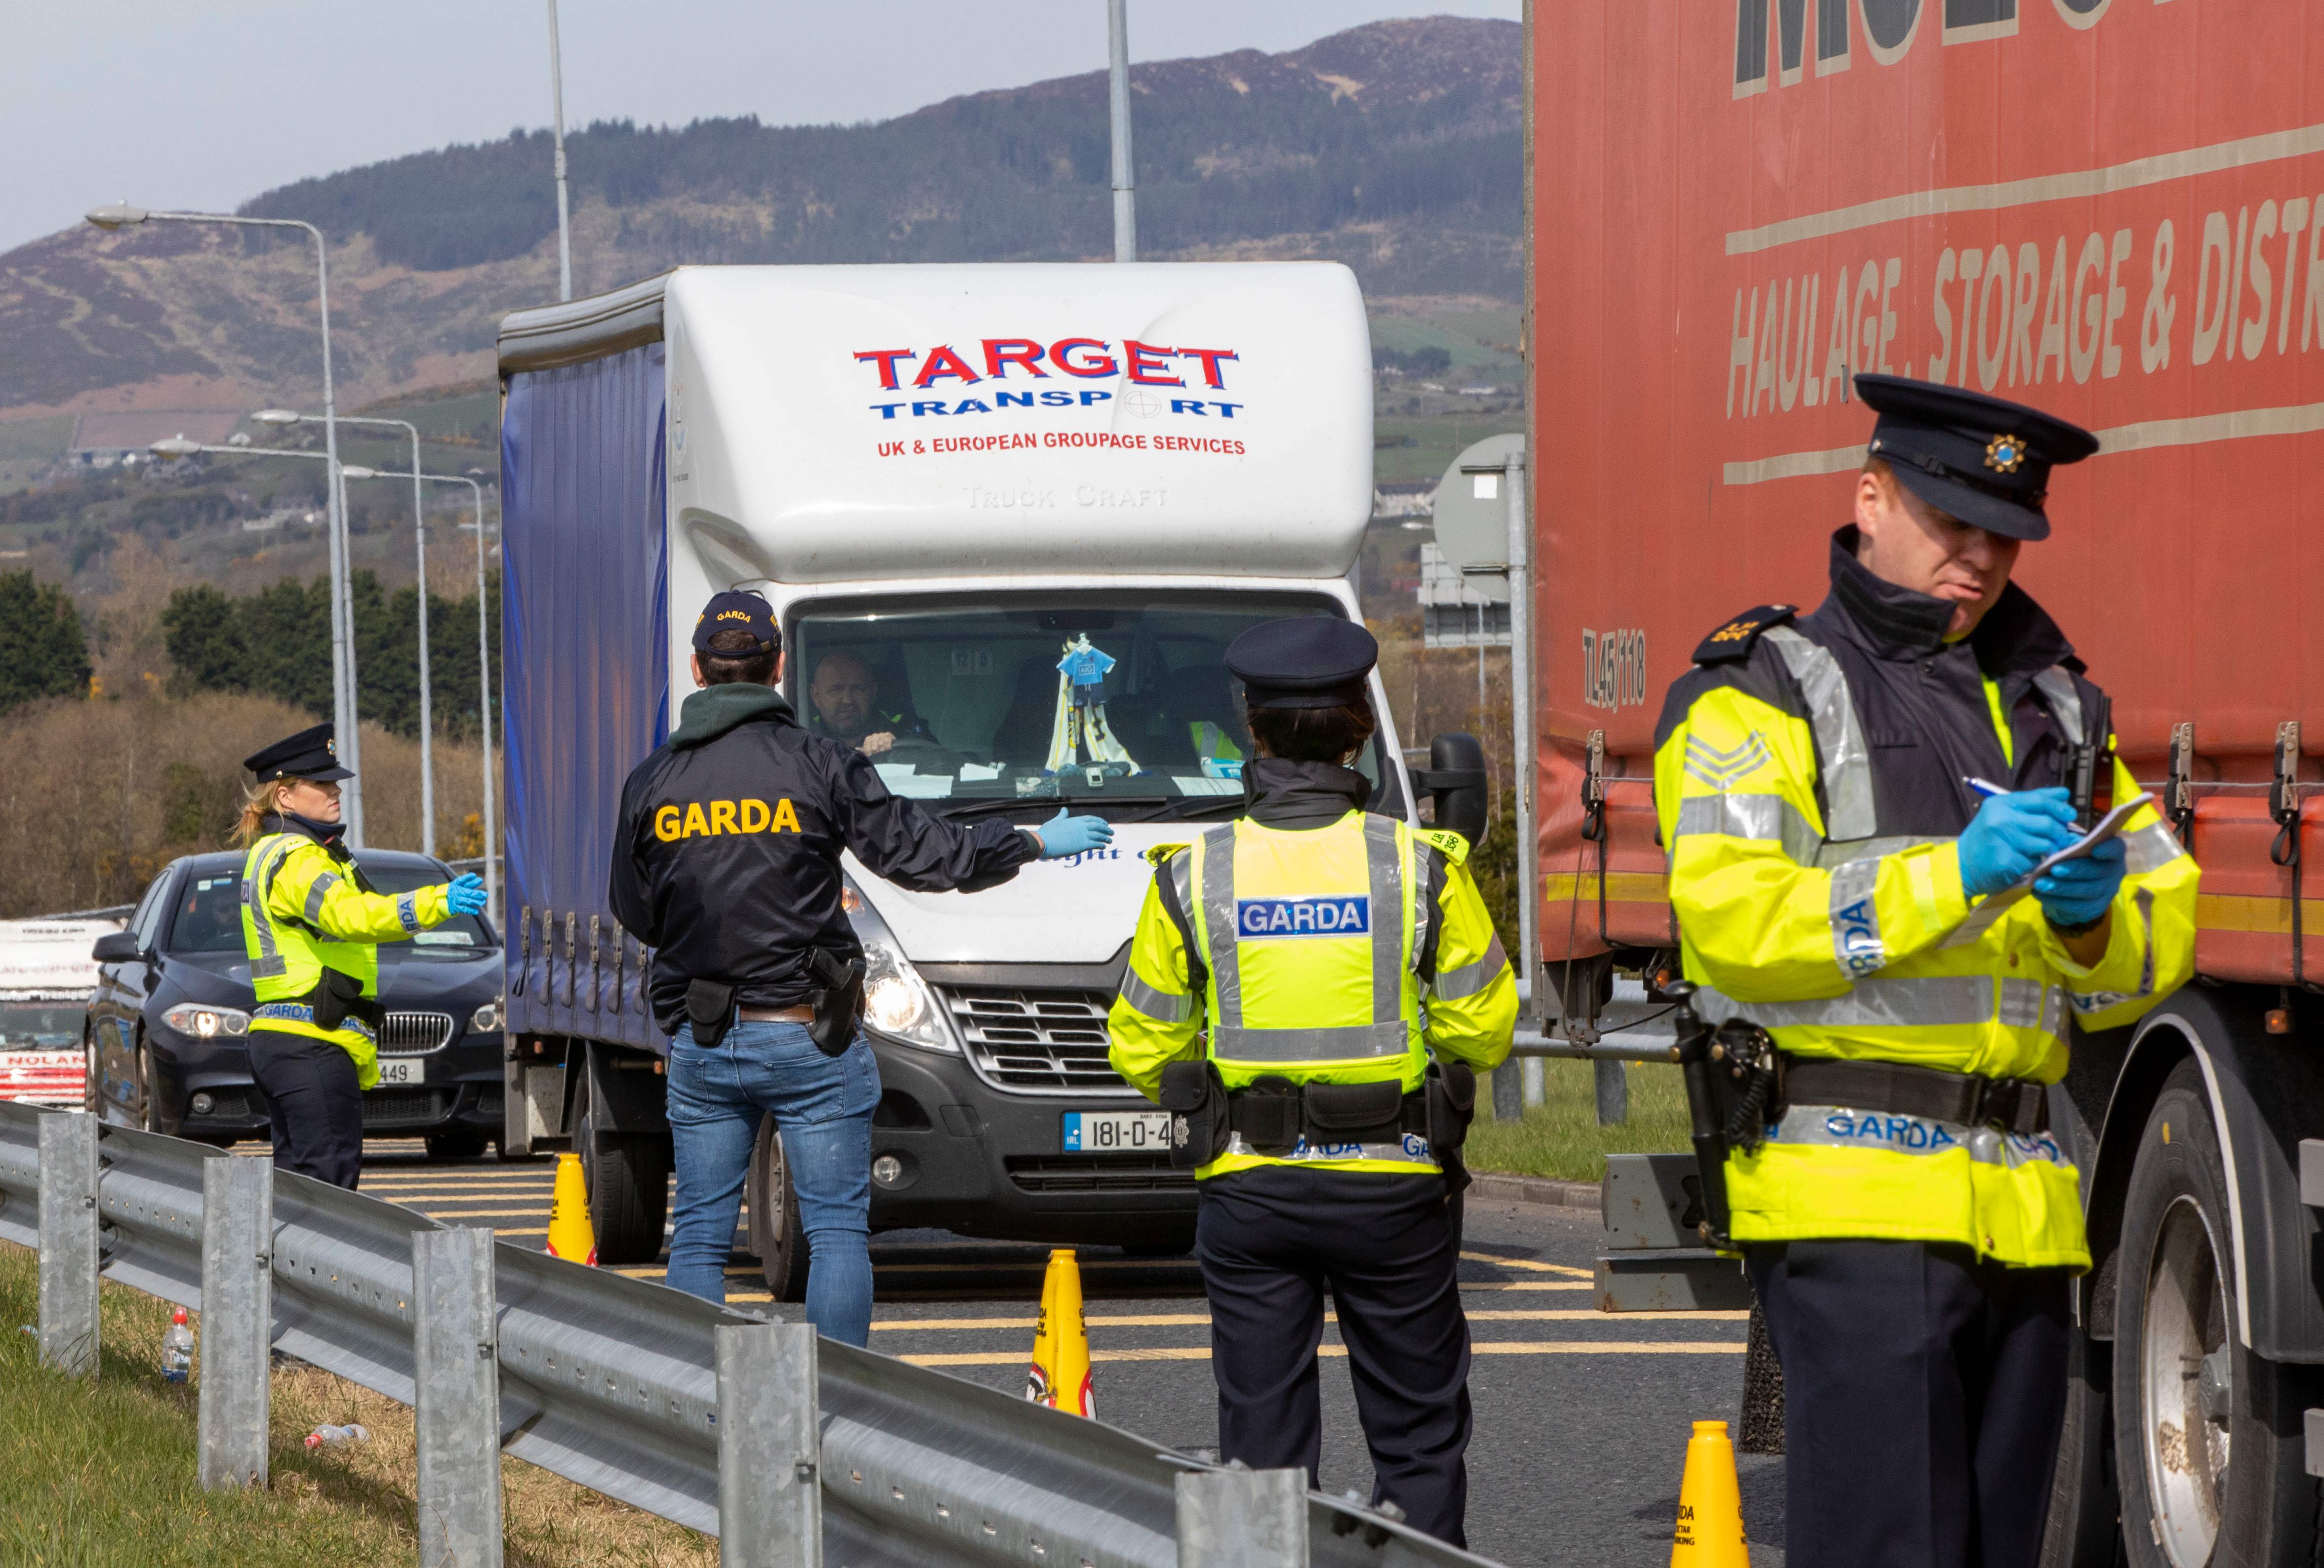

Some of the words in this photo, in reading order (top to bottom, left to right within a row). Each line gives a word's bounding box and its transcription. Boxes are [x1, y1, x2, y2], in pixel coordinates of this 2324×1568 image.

[1928, 229, 2132, 392] STORAGE
[2140, 219, 2176, 374] &
[853, 337, 1240, 391] TARGET
[878, 441, 906, 457] UK
[913, 440, 926, 454] &
[933, 433, 1038, 453] EUROPEAN
[1044, 432, 1147, 449] GROUPAGE
[1153, 435, 1245, 455] SERVICES
[717, 610, 751, 623] GARDA
[1583, 628, 1645, 714] TL45/118
[655, 798, 802, 842] GARDA
[1431, 833, 1445, 844] LH
[1243, 902, 1363, 932] GARDA
[265, 1004, 313, 1020] GARDA
[7, 1056, 85, 1065] NOLAN
[1066, 1136, 1079, 1145] IRL
[1828, 1116, 1955, 1149] GARDA
